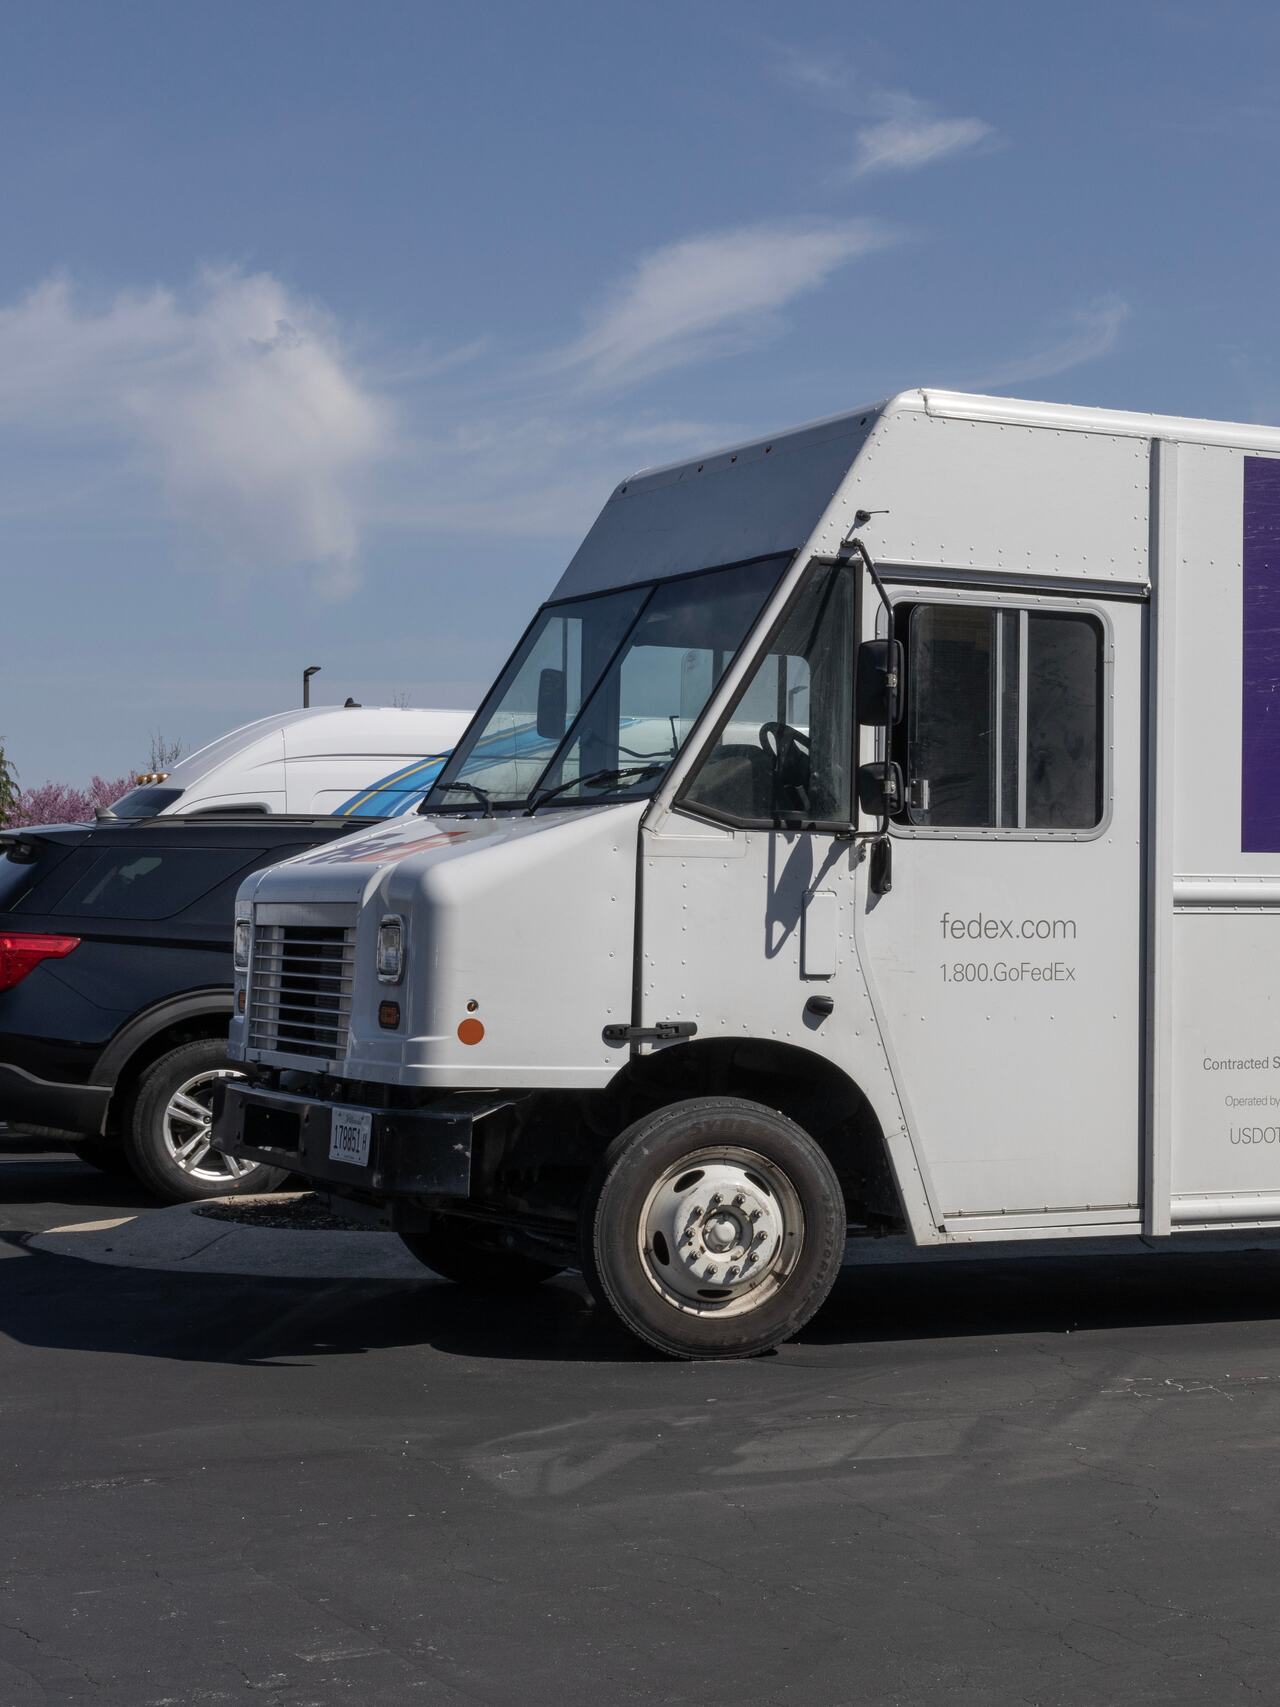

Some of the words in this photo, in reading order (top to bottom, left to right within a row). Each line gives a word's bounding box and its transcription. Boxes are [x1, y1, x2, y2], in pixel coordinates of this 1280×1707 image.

[939, 911, 1077, 940] fedex.com
[939, 961, 1076, 983] 1.800.GoFedEx
[1202, 1056, 1269, 1071] Contracted
[1224, 1095, 1268, 1107] Operated
[1269, 1095, 1280, 1108] by
